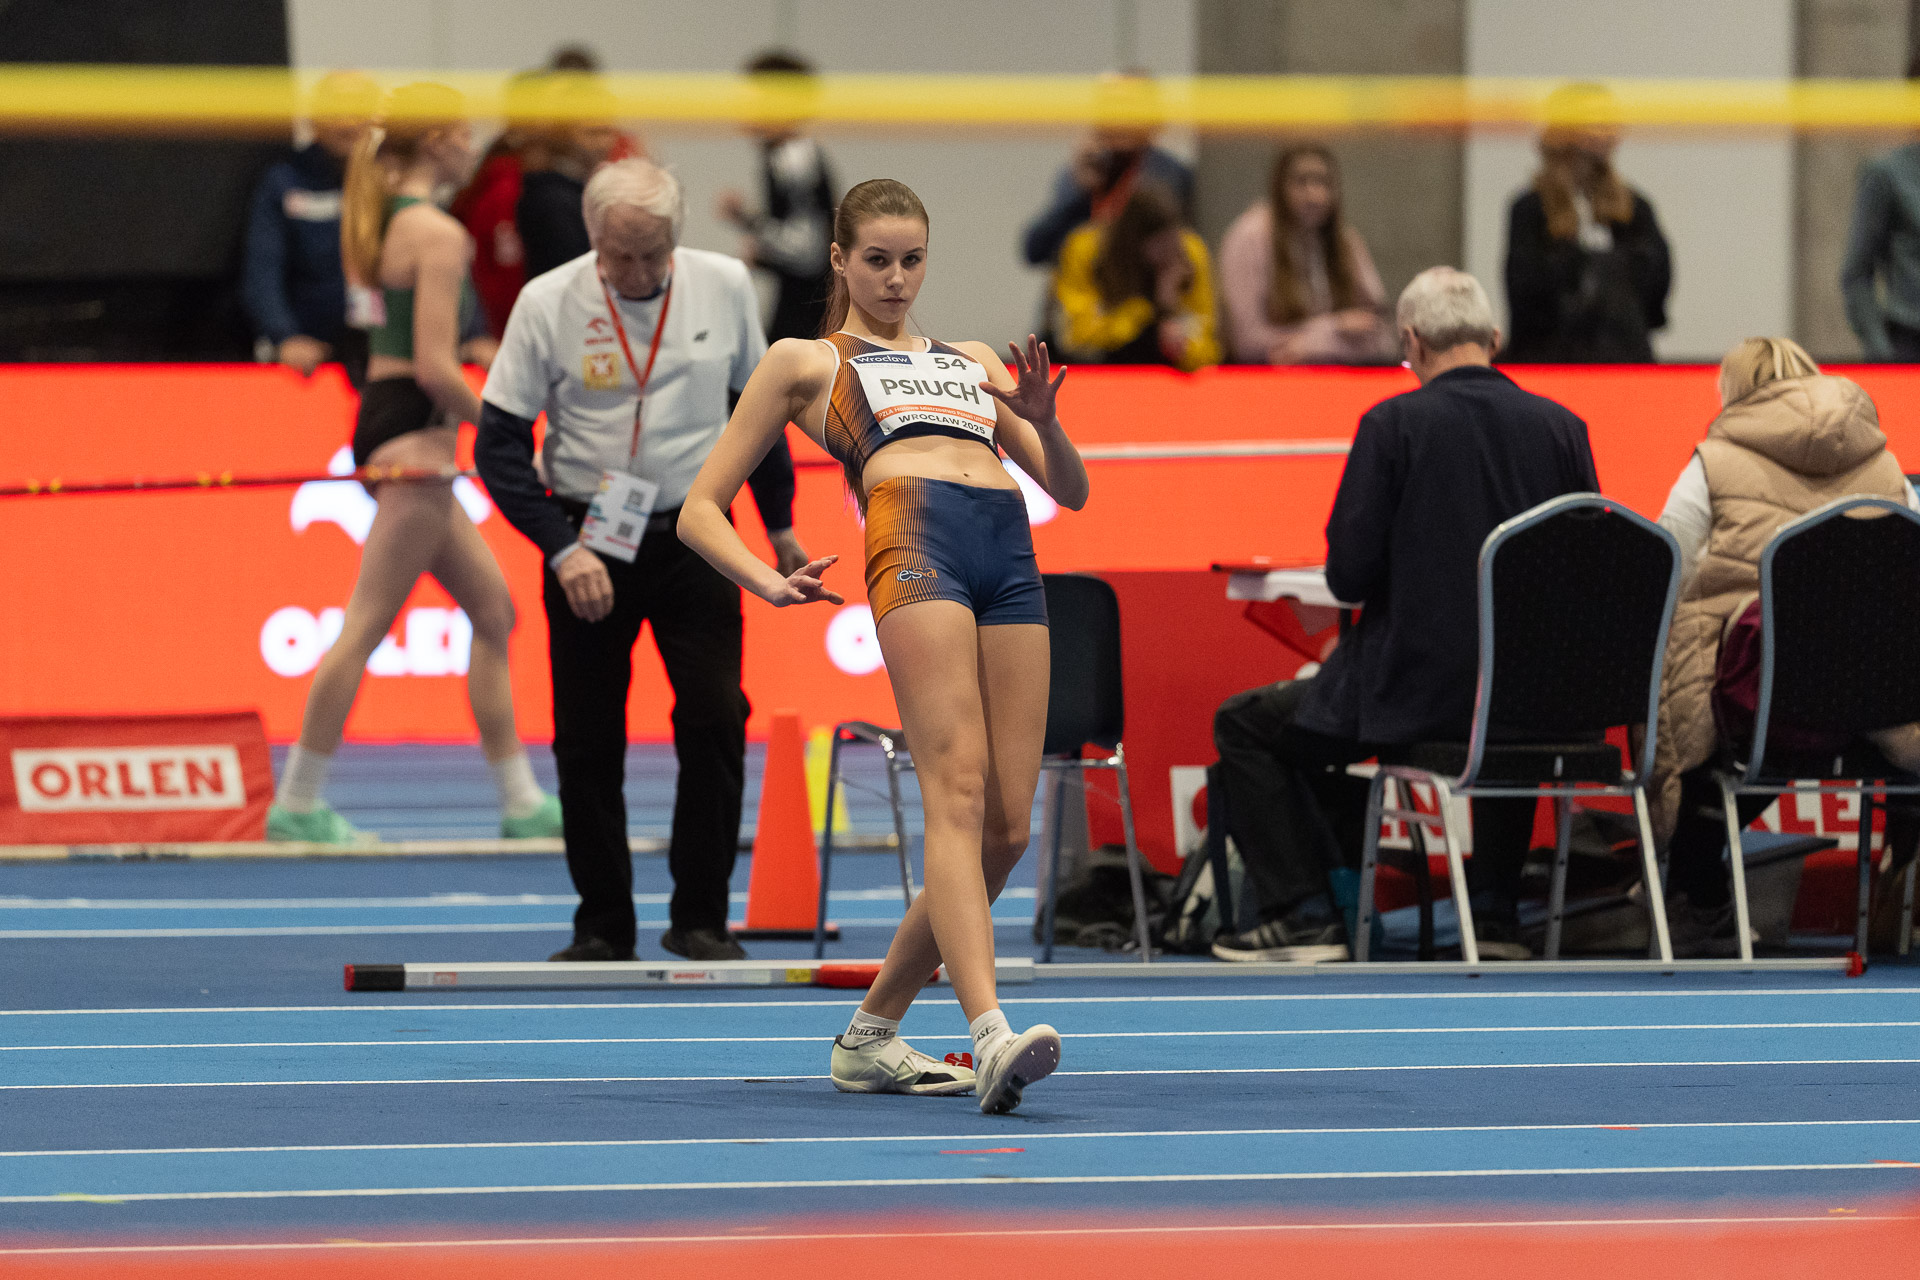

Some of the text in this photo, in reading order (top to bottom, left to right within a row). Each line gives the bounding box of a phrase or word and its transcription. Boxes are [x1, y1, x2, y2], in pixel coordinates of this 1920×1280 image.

[934, 357, 967, 370] 54
[880, 378, 980, 405] PSIUCH
[878, 409, 894, 418] PZLA
[961, 420, 986, 434] 2025
[30, 759, 225, 799] ORLEN
[847, 1024, 892, 1037] EVERLAST
